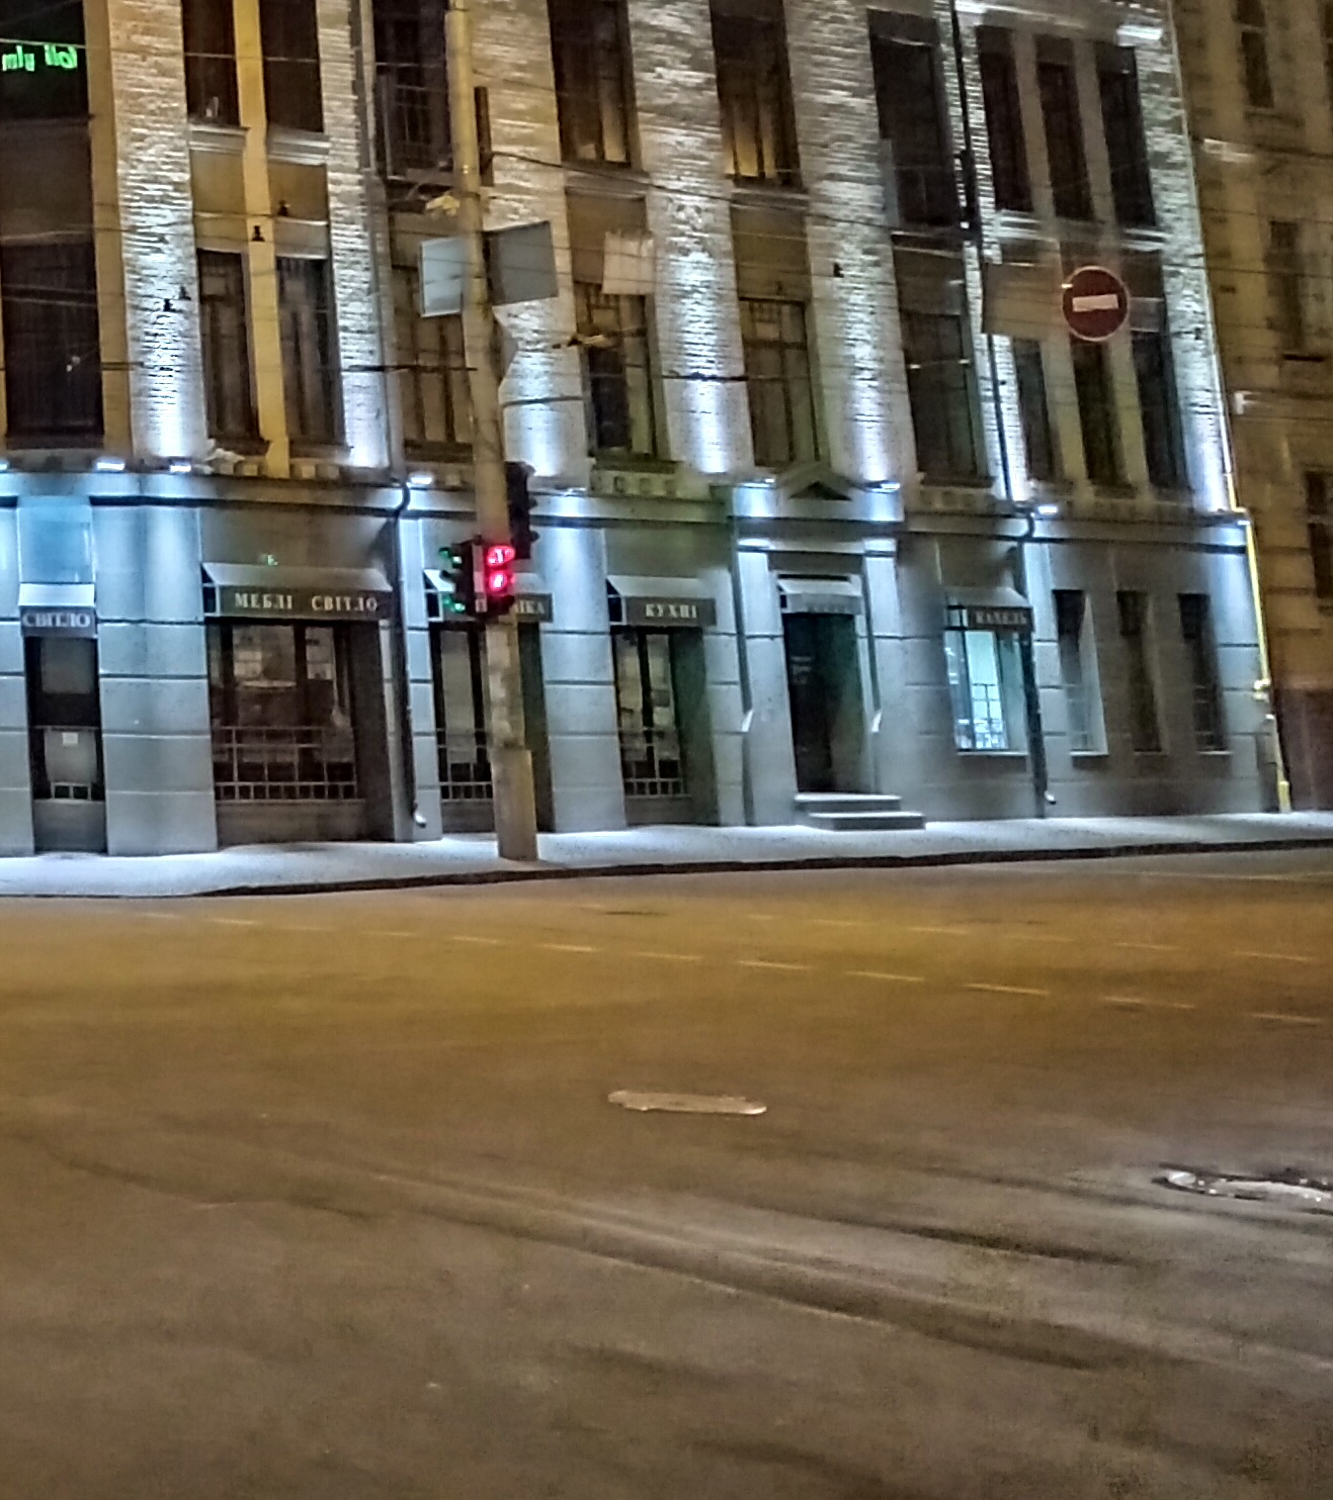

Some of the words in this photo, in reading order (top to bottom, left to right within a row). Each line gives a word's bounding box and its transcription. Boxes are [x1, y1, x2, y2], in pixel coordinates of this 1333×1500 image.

[234, 593, 293, 609] МЕБЛІ
[311, 595, 378, 611] СВІТЛО
[21, 612, 91, 628] СВІТЛО
